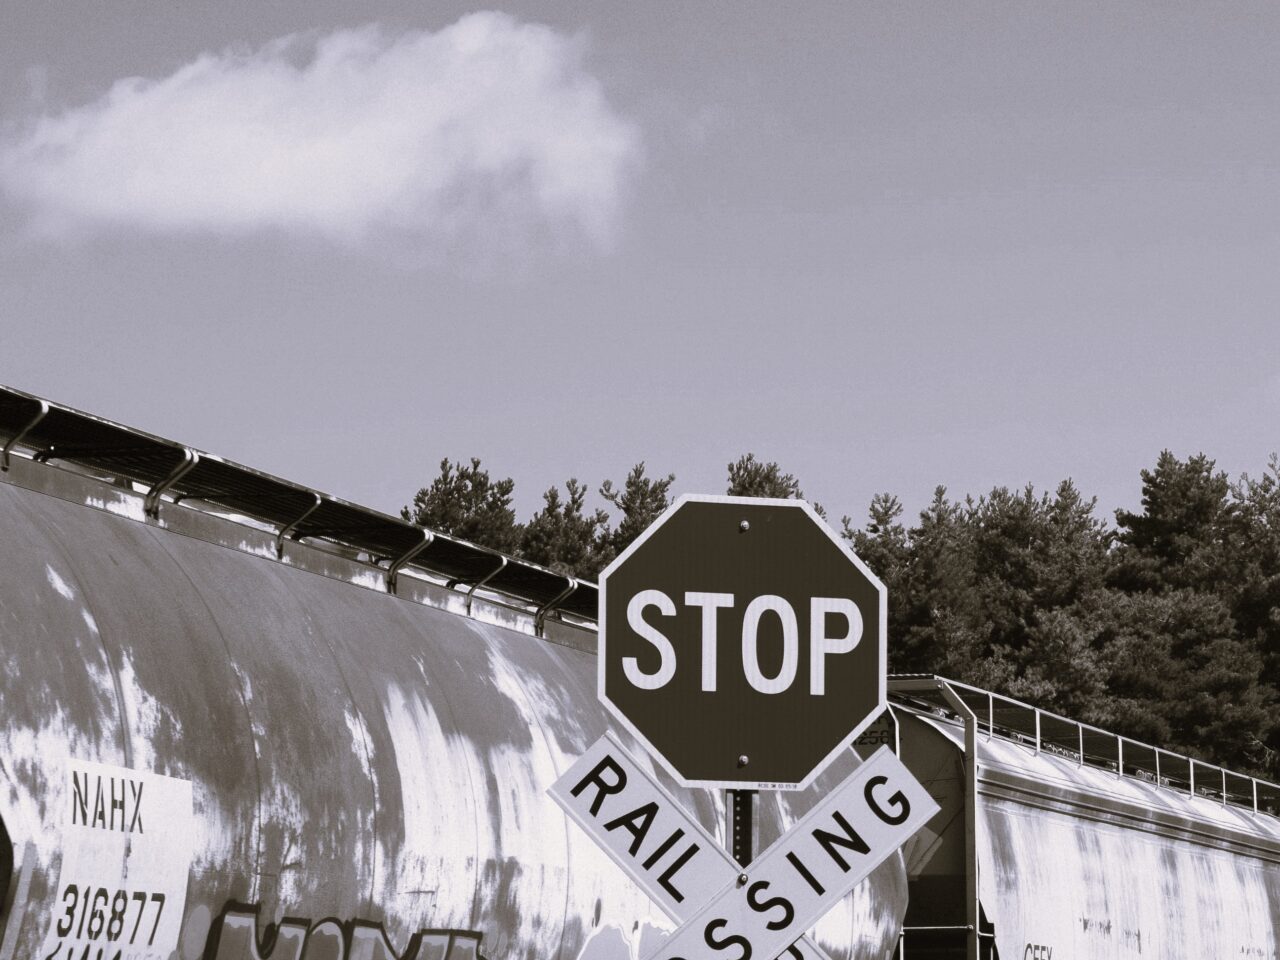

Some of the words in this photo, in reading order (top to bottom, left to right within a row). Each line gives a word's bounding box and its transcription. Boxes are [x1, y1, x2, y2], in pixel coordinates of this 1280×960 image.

[621, 589, 864, 696] STOP
[72, 770, 144, 834] NAHX
[571, 754, 700, 903] RAIL
[57, 884, 165, 946] 316877
